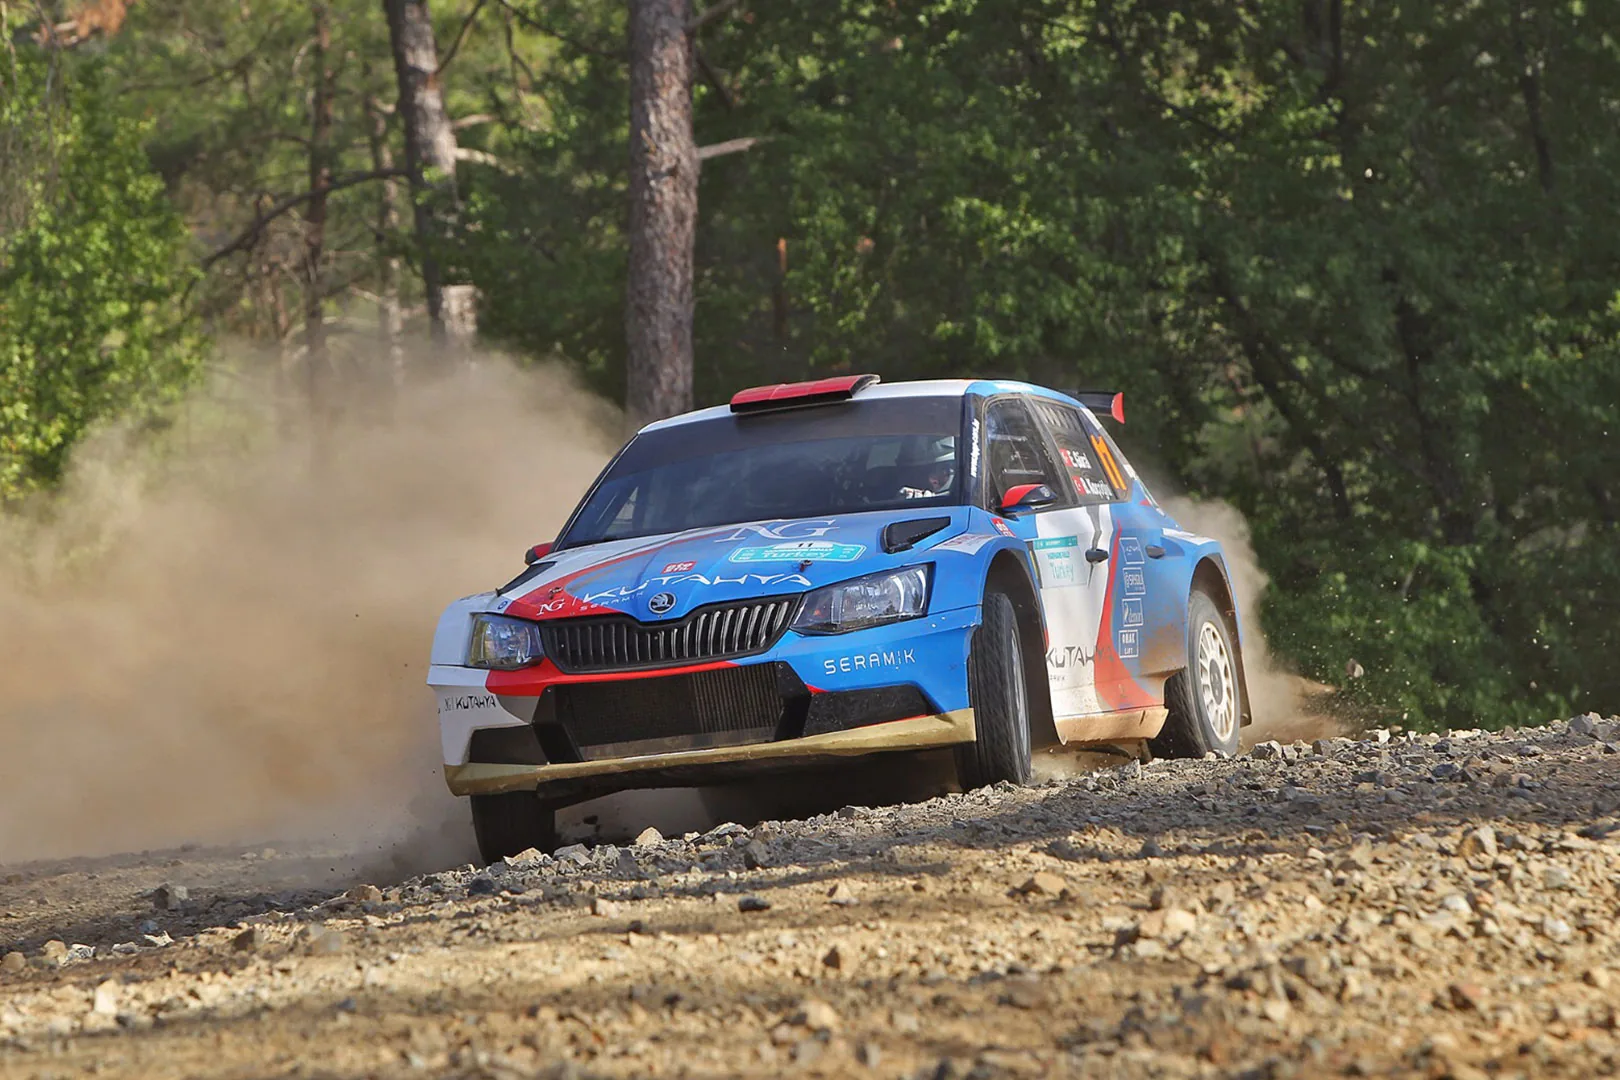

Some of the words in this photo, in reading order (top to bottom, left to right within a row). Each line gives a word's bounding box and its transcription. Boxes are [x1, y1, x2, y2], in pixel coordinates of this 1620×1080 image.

[1090, 434, 1127, 490] 11
[714, 519, 840, 543] NG
[762, 550, 830, 558] Turkey
[536, 598, 566, 616] NG
